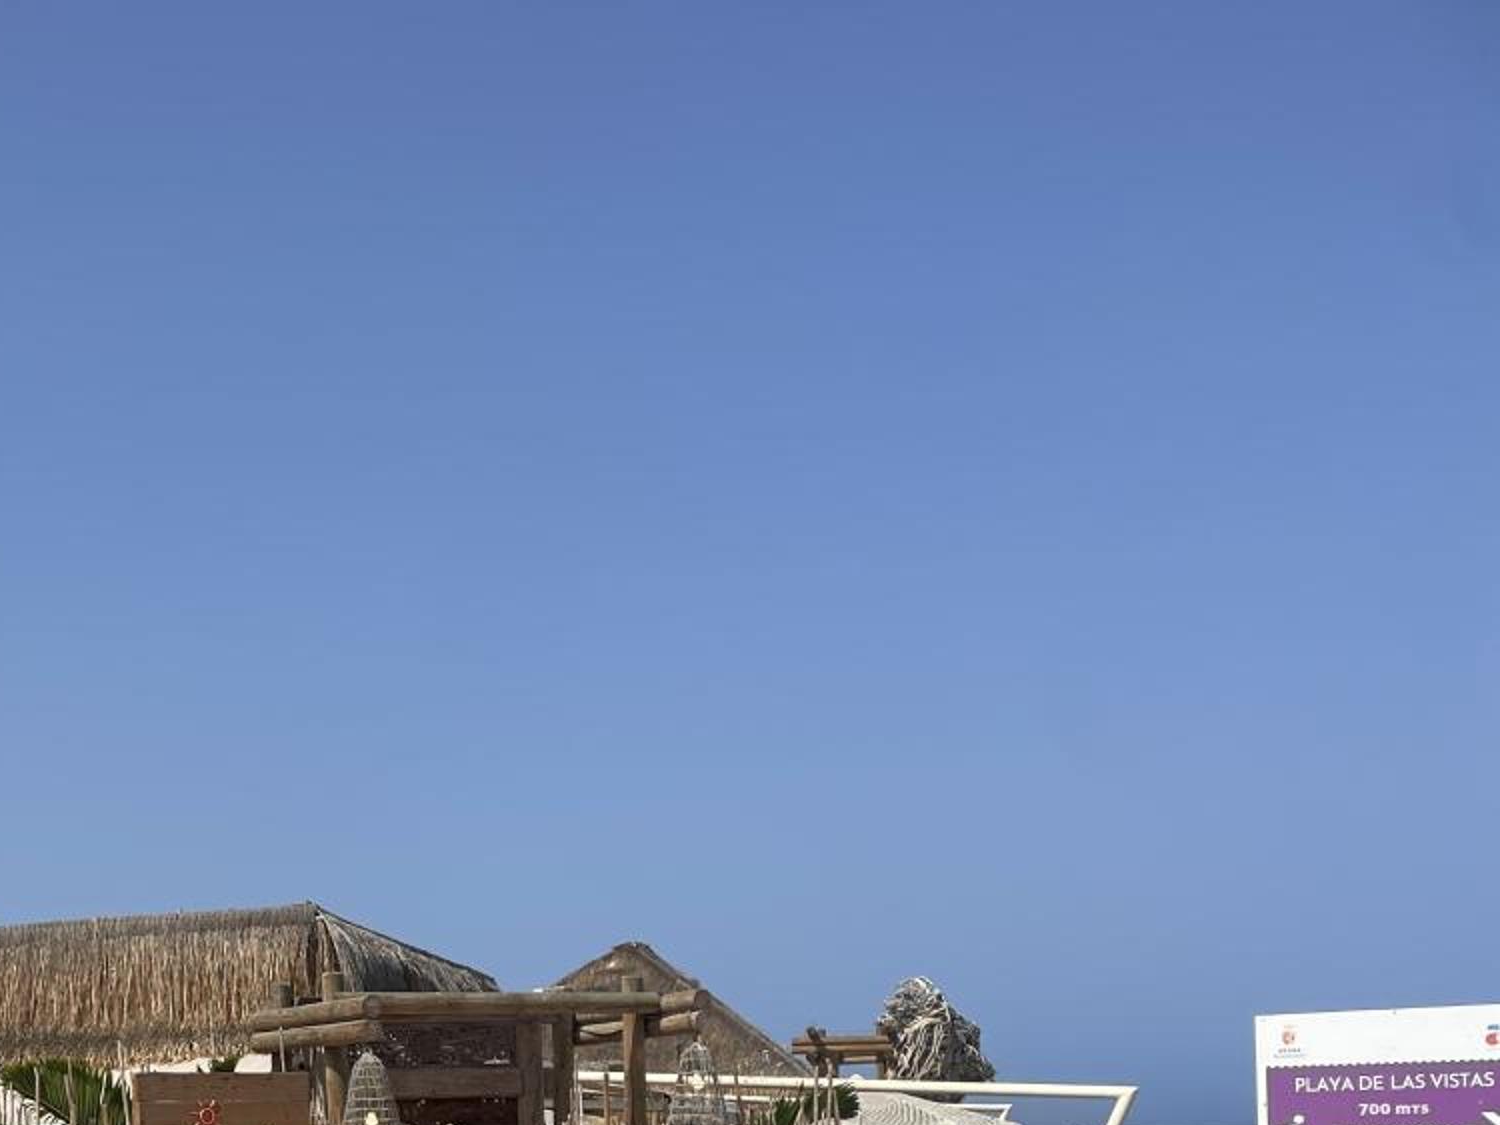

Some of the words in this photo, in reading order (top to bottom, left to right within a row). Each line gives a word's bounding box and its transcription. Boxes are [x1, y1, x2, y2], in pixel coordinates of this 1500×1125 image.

[1294, 1076, 1355, 1093] PLAYA
[1358, 1075, 1386, 1092] DE
[1390, 1073, 1426, 1090] LAS
[1429, 1071, 1496, 1089] VISTAS
[1357, 1103, 1391, 1117] 700
